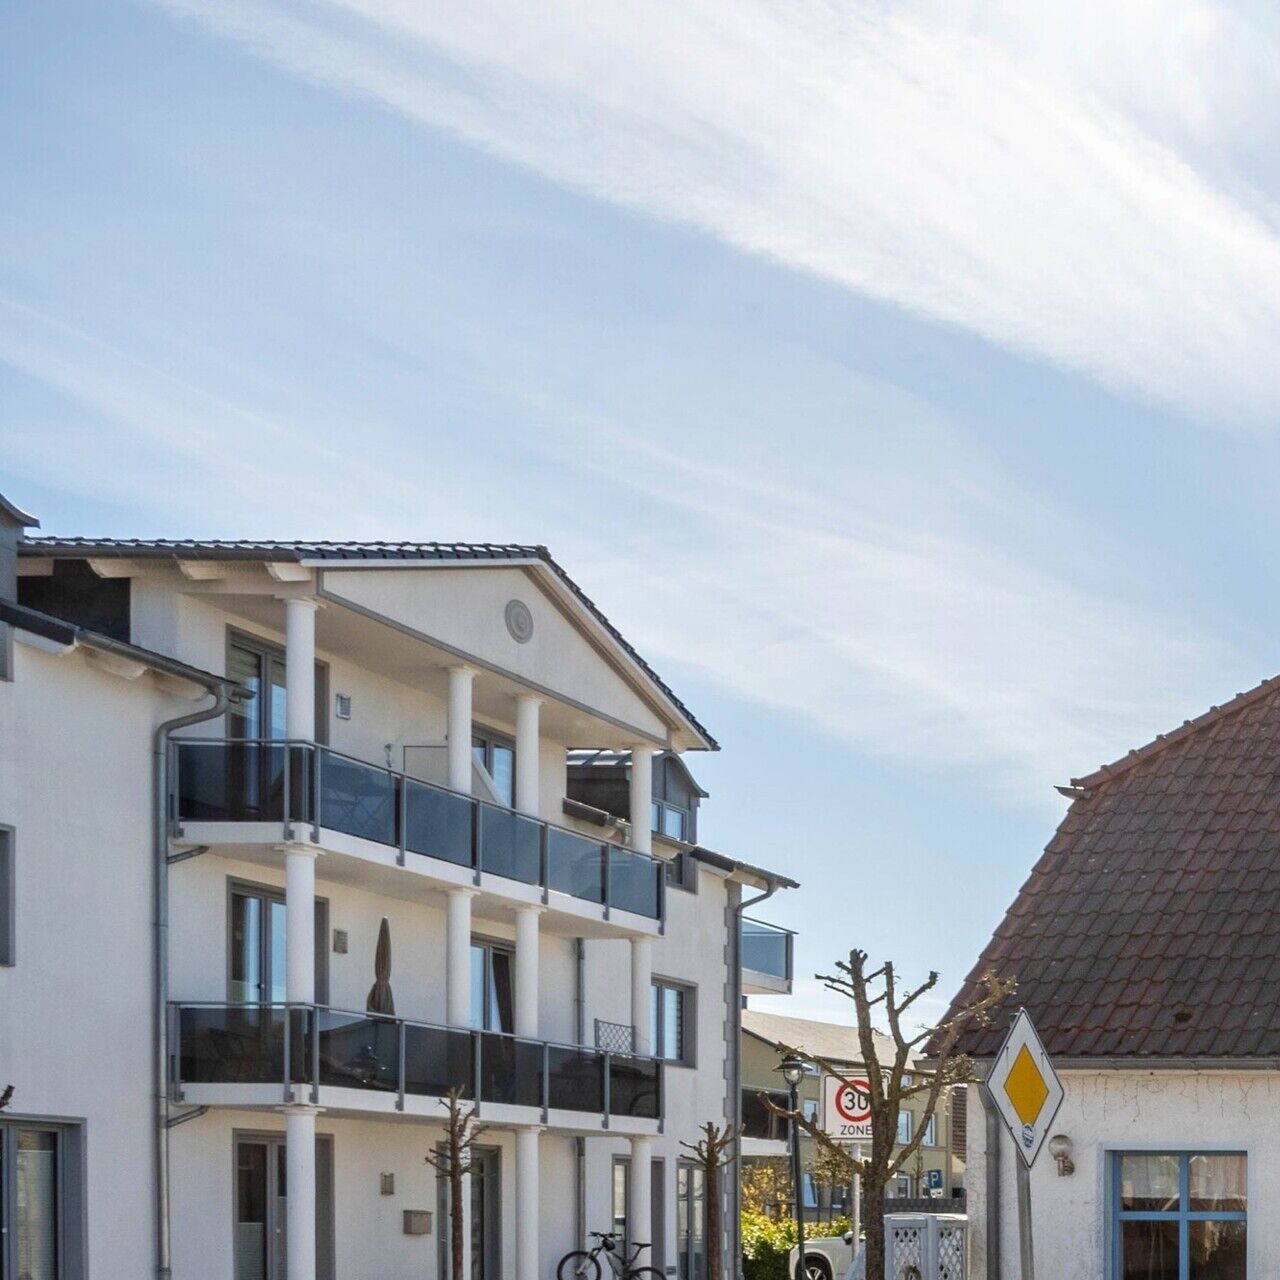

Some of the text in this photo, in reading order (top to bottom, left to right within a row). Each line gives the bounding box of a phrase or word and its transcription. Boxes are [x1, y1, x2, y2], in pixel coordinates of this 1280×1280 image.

[844, 1091, 869, 1110] 30
[840, 1125, 873, 1136] ZONE
[930, 1171, 939, 1187] P
